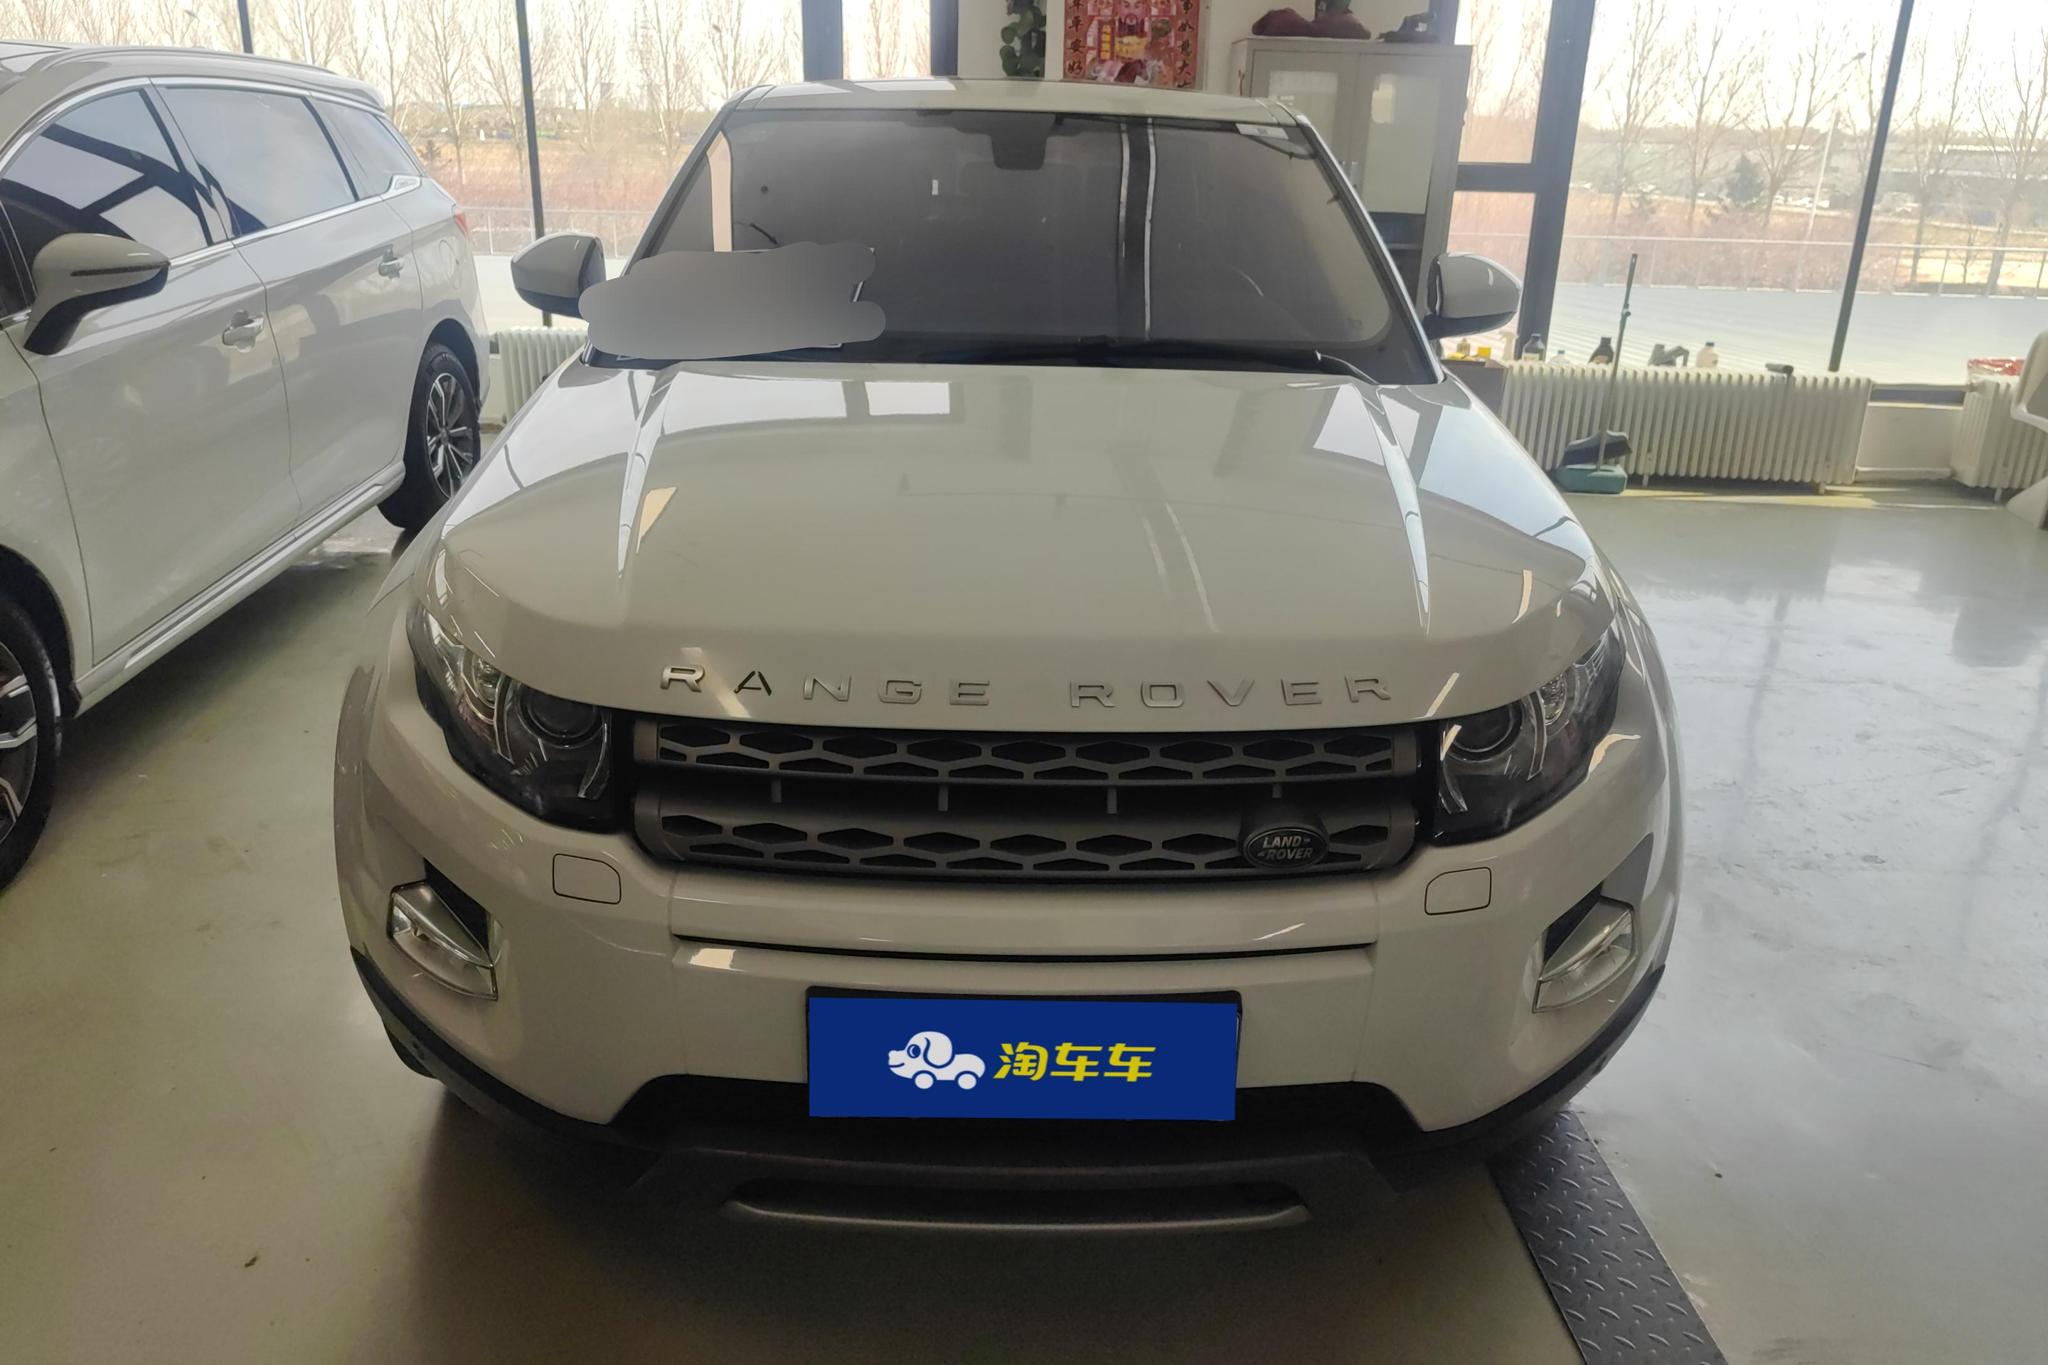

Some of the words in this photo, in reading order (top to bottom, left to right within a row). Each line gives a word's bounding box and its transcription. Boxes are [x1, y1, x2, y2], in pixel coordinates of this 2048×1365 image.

[660, 664, 991, 707] RANGE
[1069, 674, 1392, 709] ROVER
[1262, 835, 1302, 849] LAND
[1265, 847, 1314, 860] ROVER
